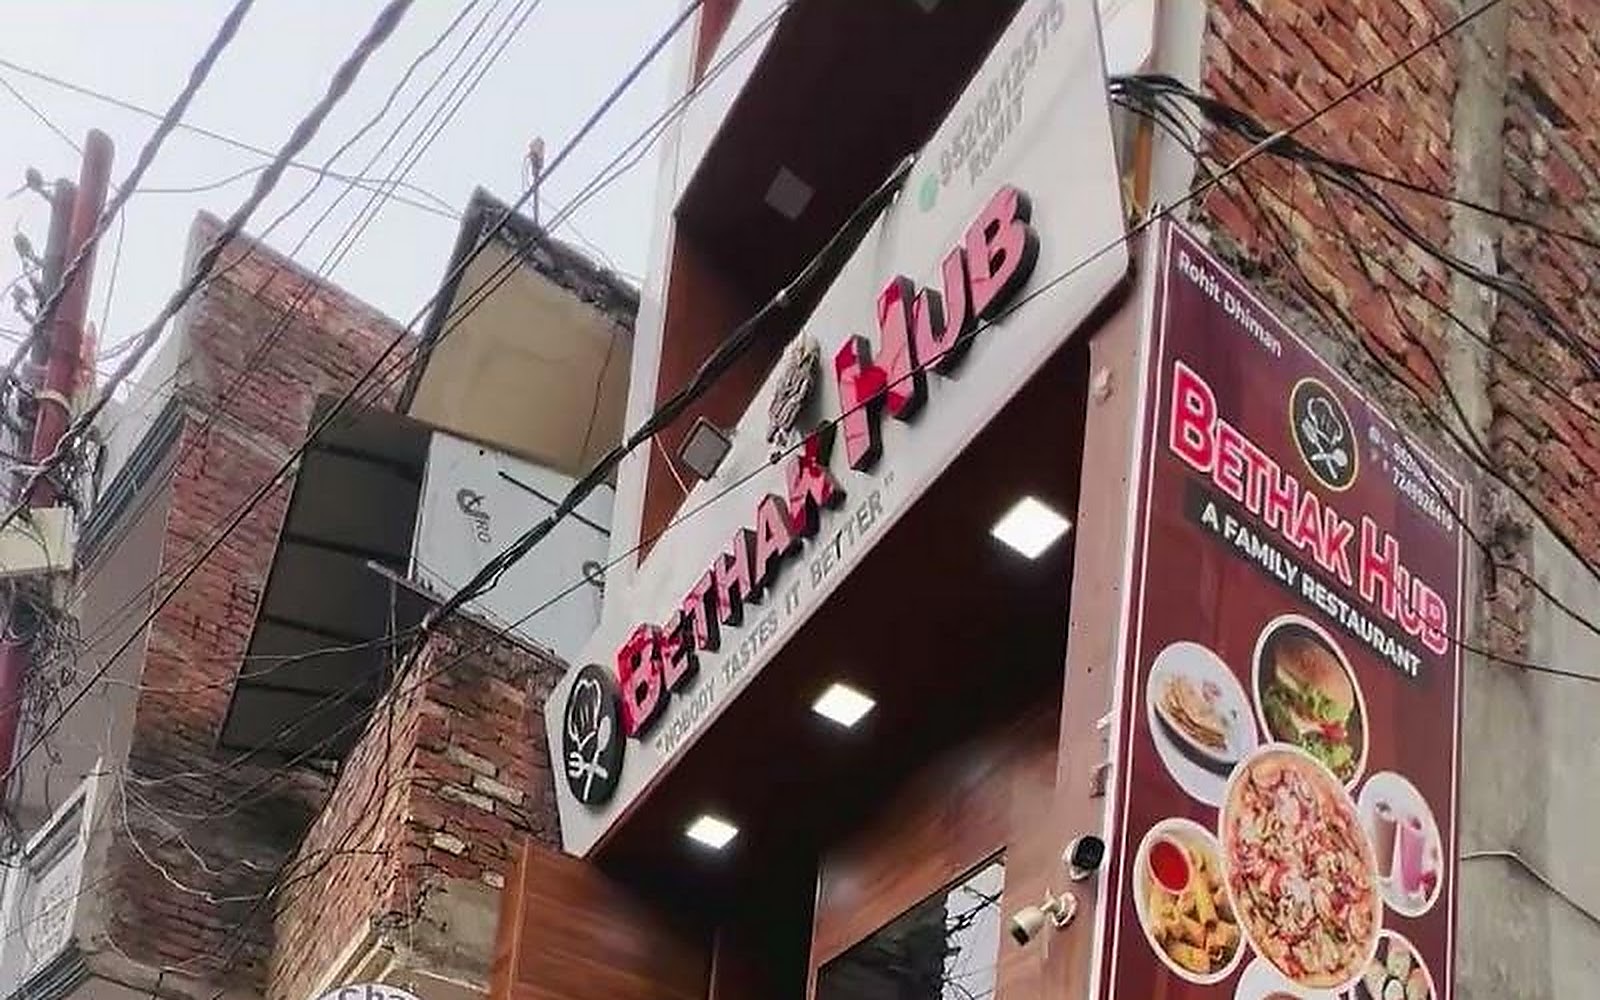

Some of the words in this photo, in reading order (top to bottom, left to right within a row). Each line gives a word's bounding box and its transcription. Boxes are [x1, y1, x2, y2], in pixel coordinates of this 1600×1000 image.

[1179, 249, 1221, 303] Rohit
[1222, 290, 1282, 358] Dhiman
[616, 423, 841, 738] BETHAK
[832, 184, 1040, 472] HUB
[1169, 360, 1356, 588] BETHAK
[1358, 516, 1449, 655] HUB
[722, 609, 778, 686] TASTES
[784, 579, 801, 616] IT
[1200, 502, 1220, 532] A
[1223, 516, 1299, 586] FAMILY
[1301, 573, 1424, 678] RESTAURANT
